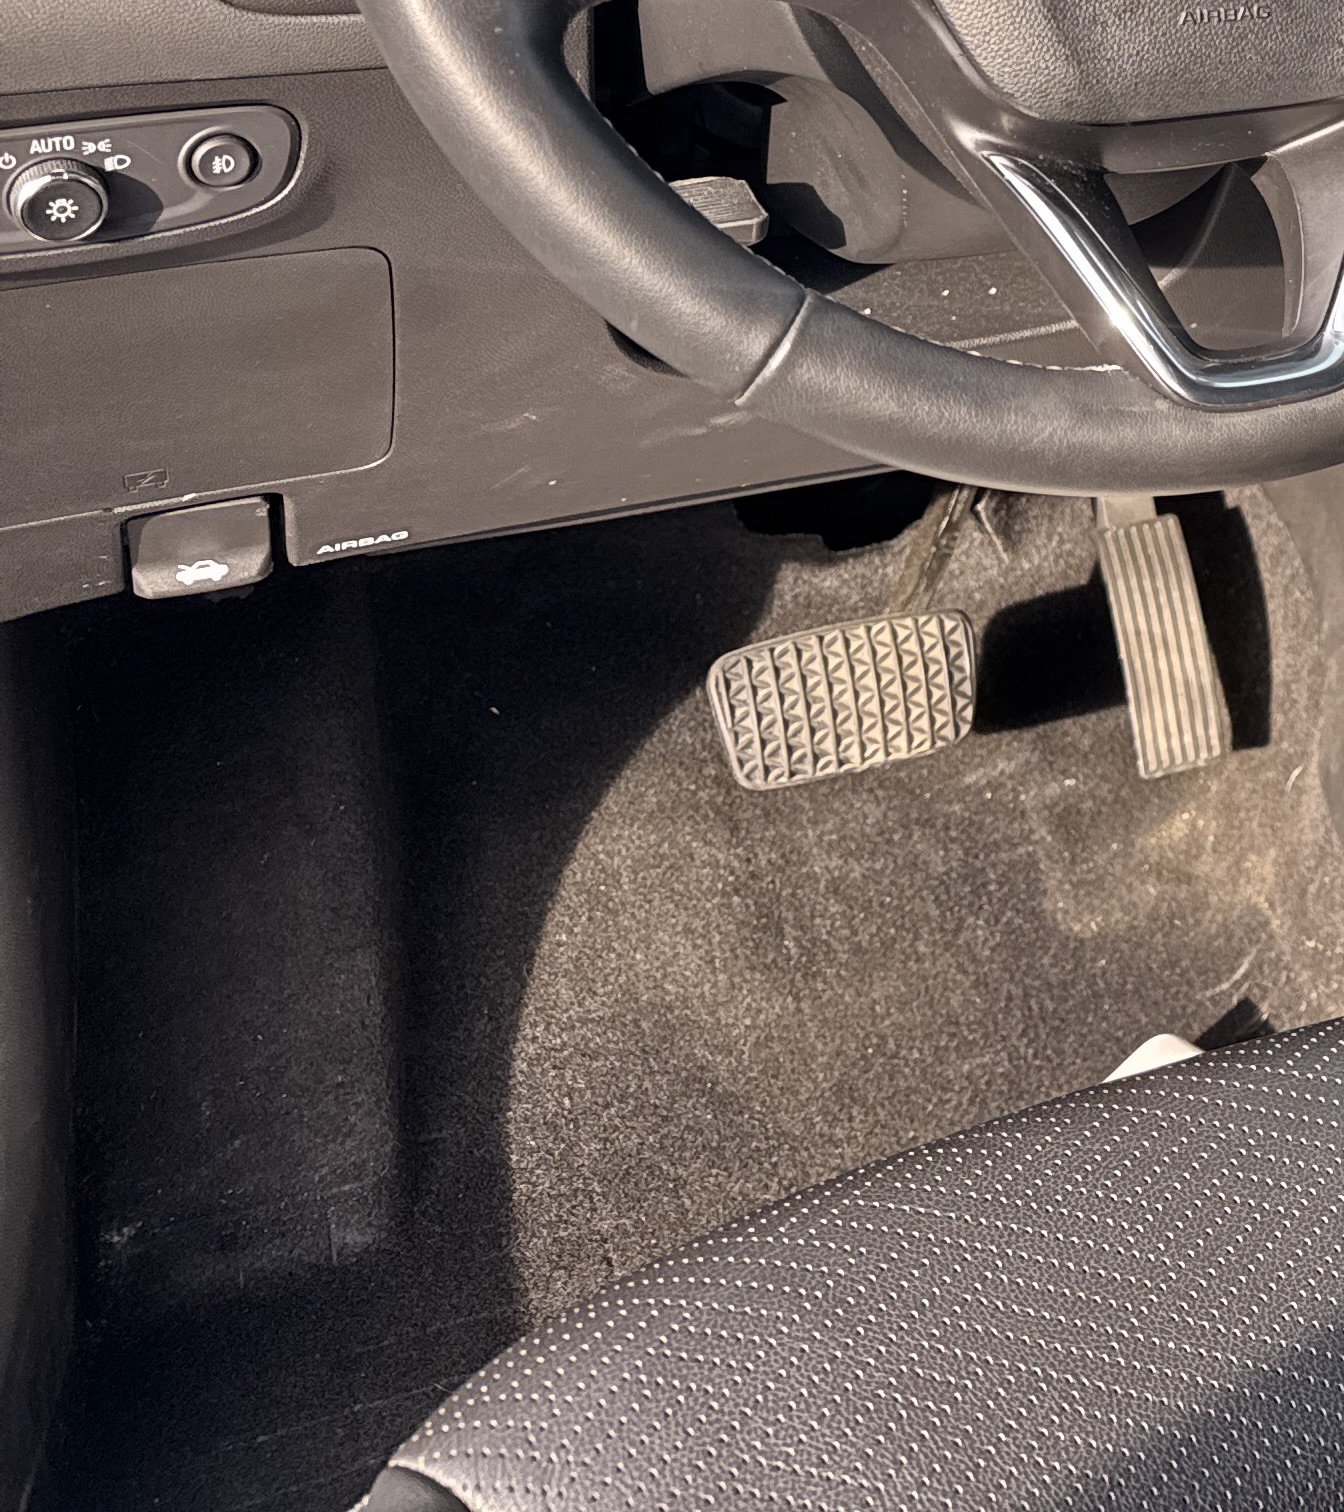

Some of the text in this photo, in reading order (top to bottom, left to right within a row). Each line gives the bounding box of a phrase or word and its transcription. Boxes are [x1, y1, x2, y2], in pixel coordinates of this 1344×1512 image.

[1178, 3, 1272, 26] AIRBAG
[29, 135, 75, 155] AUTO
[316, 530, 409, 555] AIRBAG
